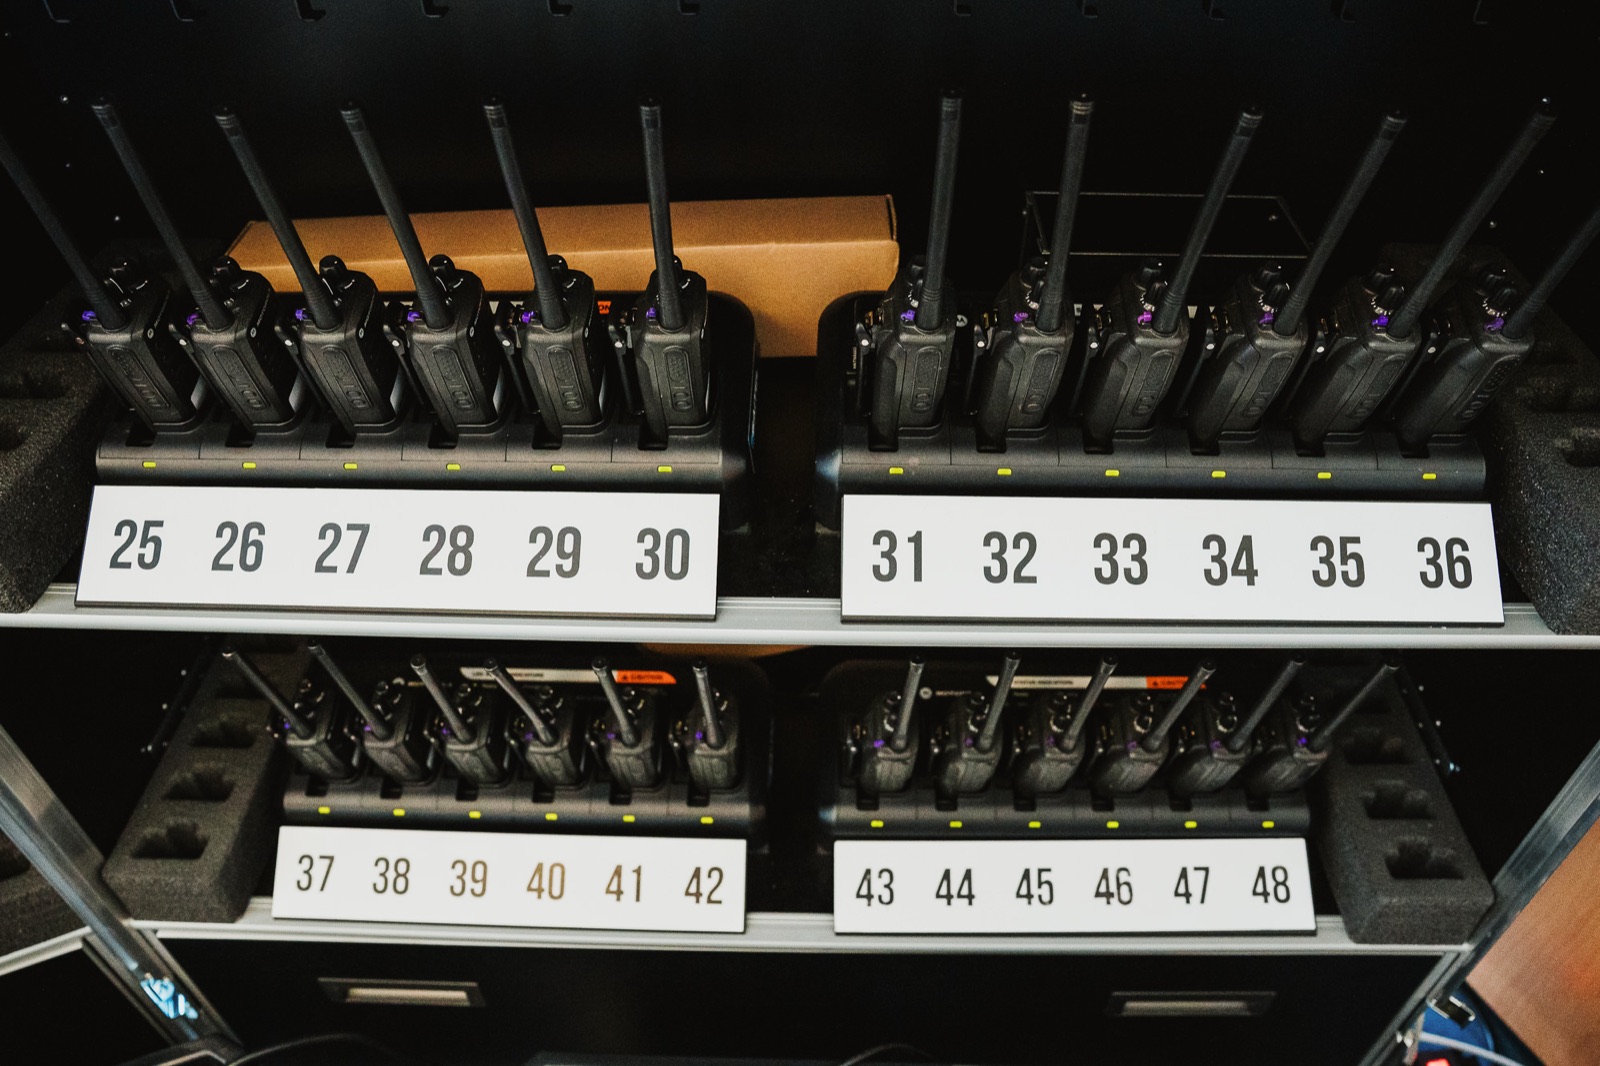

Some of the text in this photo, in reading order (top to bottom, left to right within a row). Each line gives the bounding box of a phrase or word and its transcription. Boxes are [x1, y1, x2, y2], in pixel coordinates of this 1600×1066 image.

[110, 519, 690, 580] 25 26 27 28 29 30
[873, 530, 1472, 589] 31 32 33 34 35 36
[297, 855, 723, 904] 37 38 39 40 41 42
[856, 866, 1290, 906] 43 44 45 46 47 48
